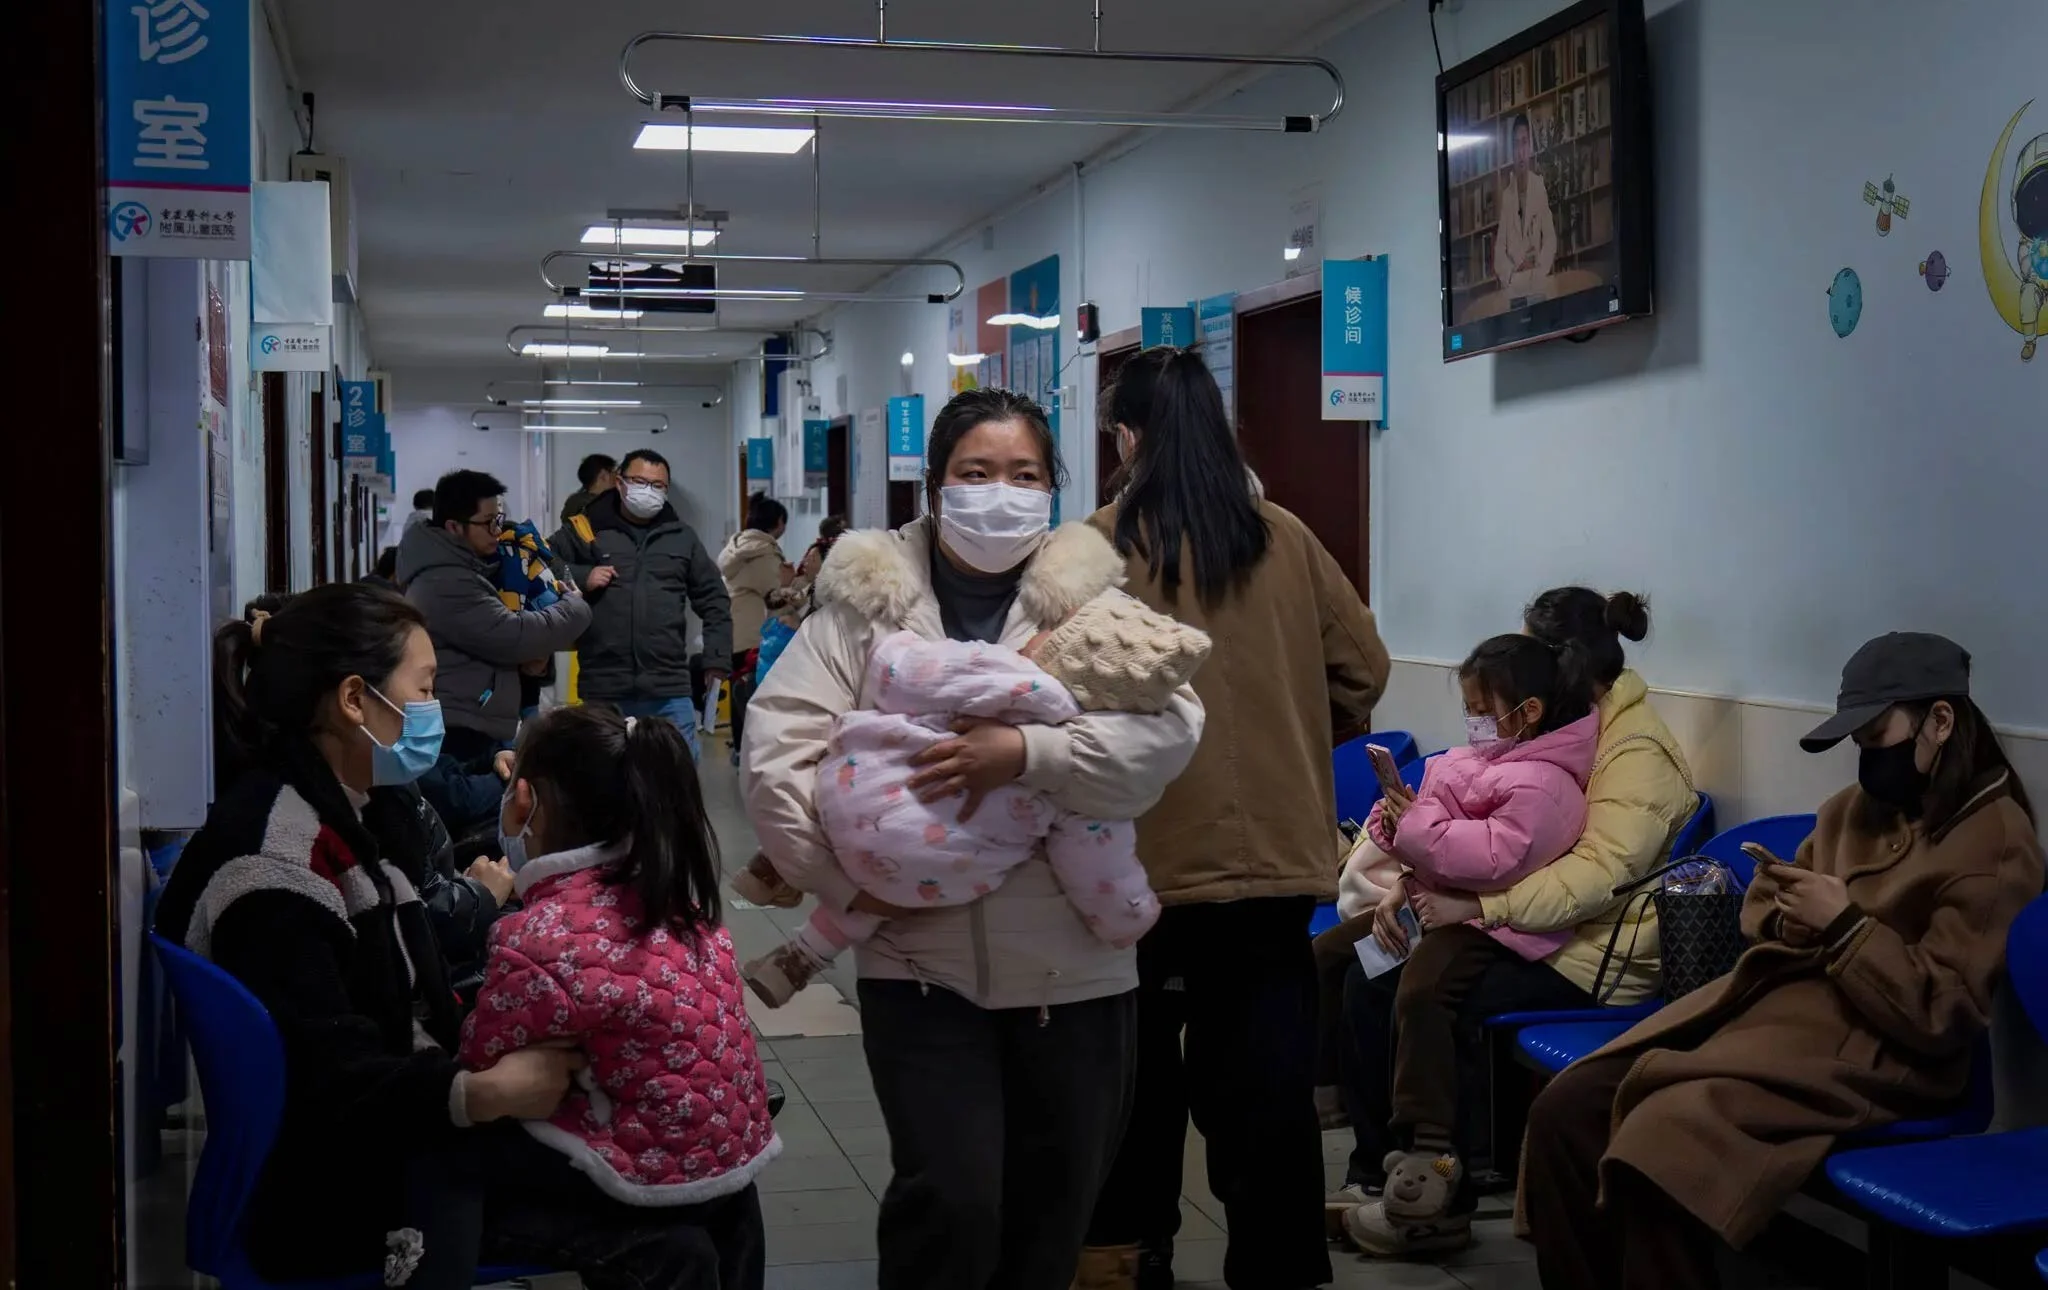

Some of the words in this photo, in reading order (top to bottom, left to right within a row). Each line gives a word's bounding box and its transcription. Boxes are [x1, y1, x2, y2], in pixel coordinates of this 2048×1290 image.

[131, 0, 209, 170] 诊室
[160, 221, 236, 236] 附属儿童医院
[1345, 286, 1362, 345] 候诊间
[347, 386, 366, 453] 2诊室
